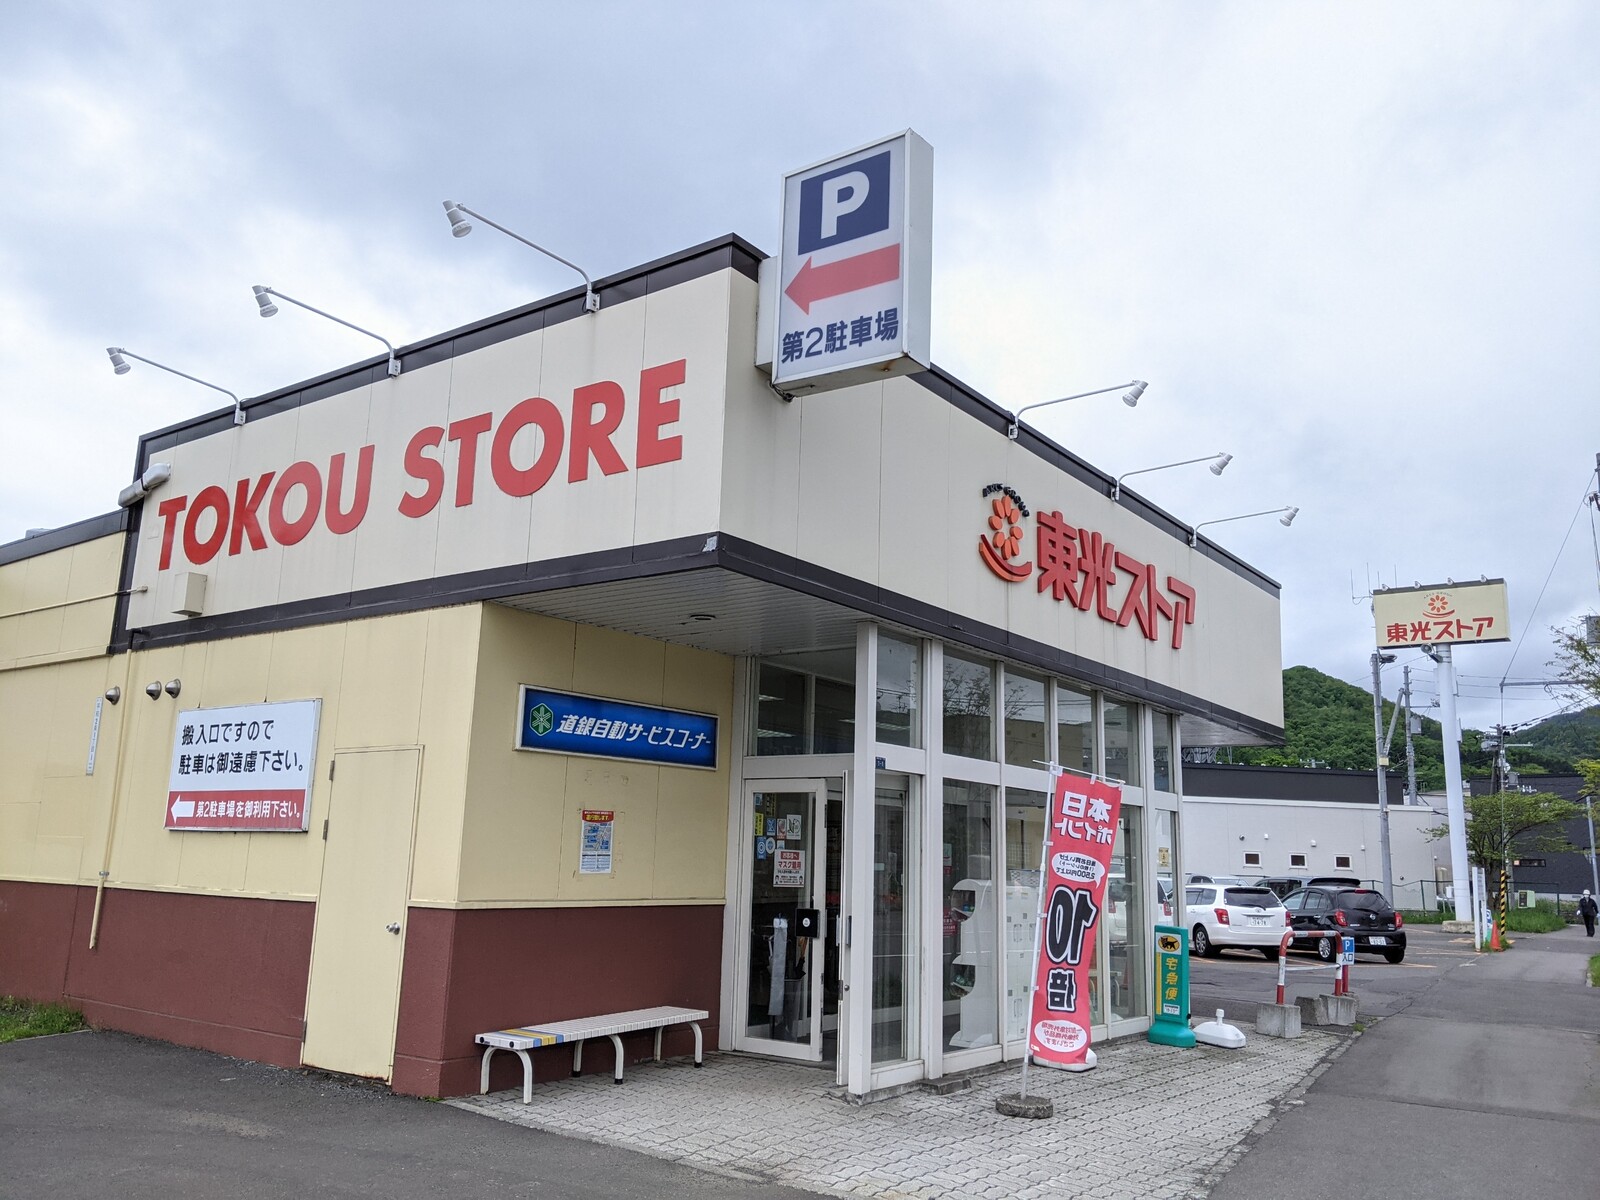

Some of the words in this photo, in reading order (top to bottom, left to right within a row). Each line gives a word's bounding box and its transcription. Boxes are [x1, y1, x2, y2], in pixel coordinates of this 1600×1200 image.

[820, 170, 870, 239] P
[781, 307, 898, 364] 第2駐車場
[158, 444, 375, 571] TOKOU
[398, 358, 686, 519] STORE
[1036, 510, 1197, 650] 東光ストア
[1386, 616, 1494, 643] 東光ストア
[181, 719, 275, 746] 搬入口ですので
[556, 714, 712, 749] 道銀自動サービスコーナー
[178, 749, 304, 775] 駐車は御遠慮下さい。
[195, 800, 301, 818] 第2駐車場を御利用下さい。
[1345, 940, 1351, 951] P
[1165, 957, 1179, 1001] 宅急便
